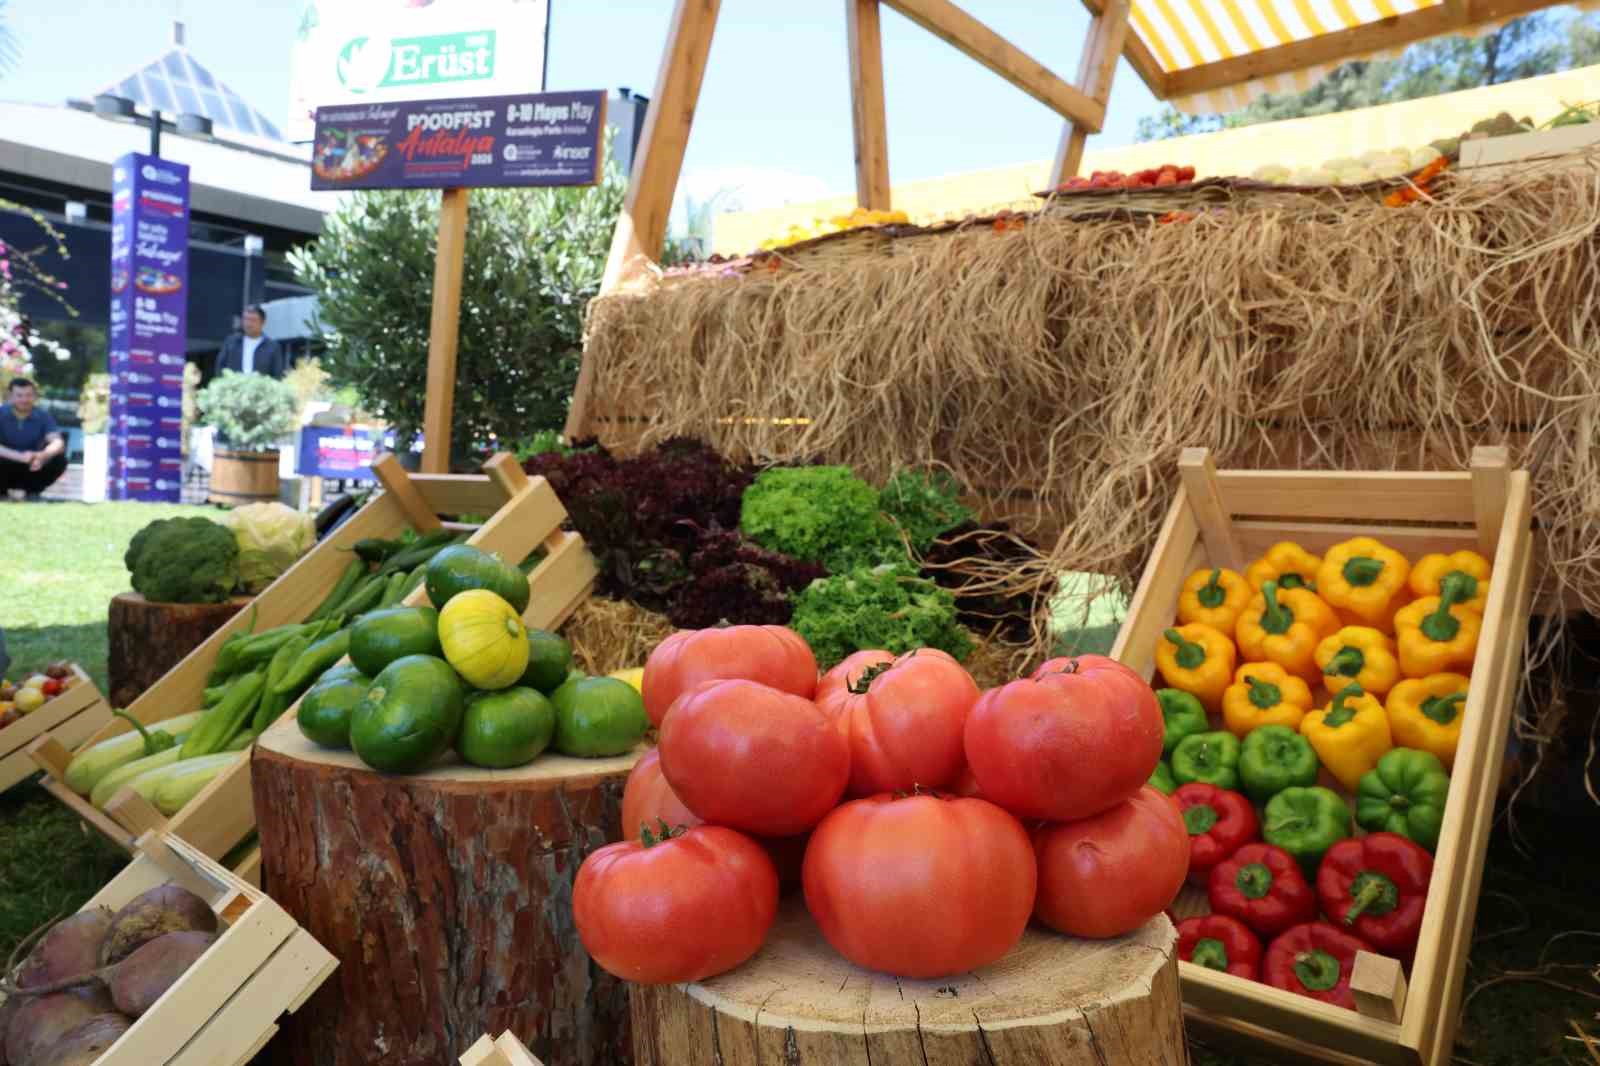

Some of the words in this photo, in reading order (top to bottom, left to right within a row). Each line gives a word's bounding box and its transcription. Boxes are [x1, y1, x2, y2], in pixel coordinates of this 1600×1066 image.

[392, 43, 490, 82] Erüst
[571, 101, 595, 125] May
[395, 125, 496, 172] Antalya
